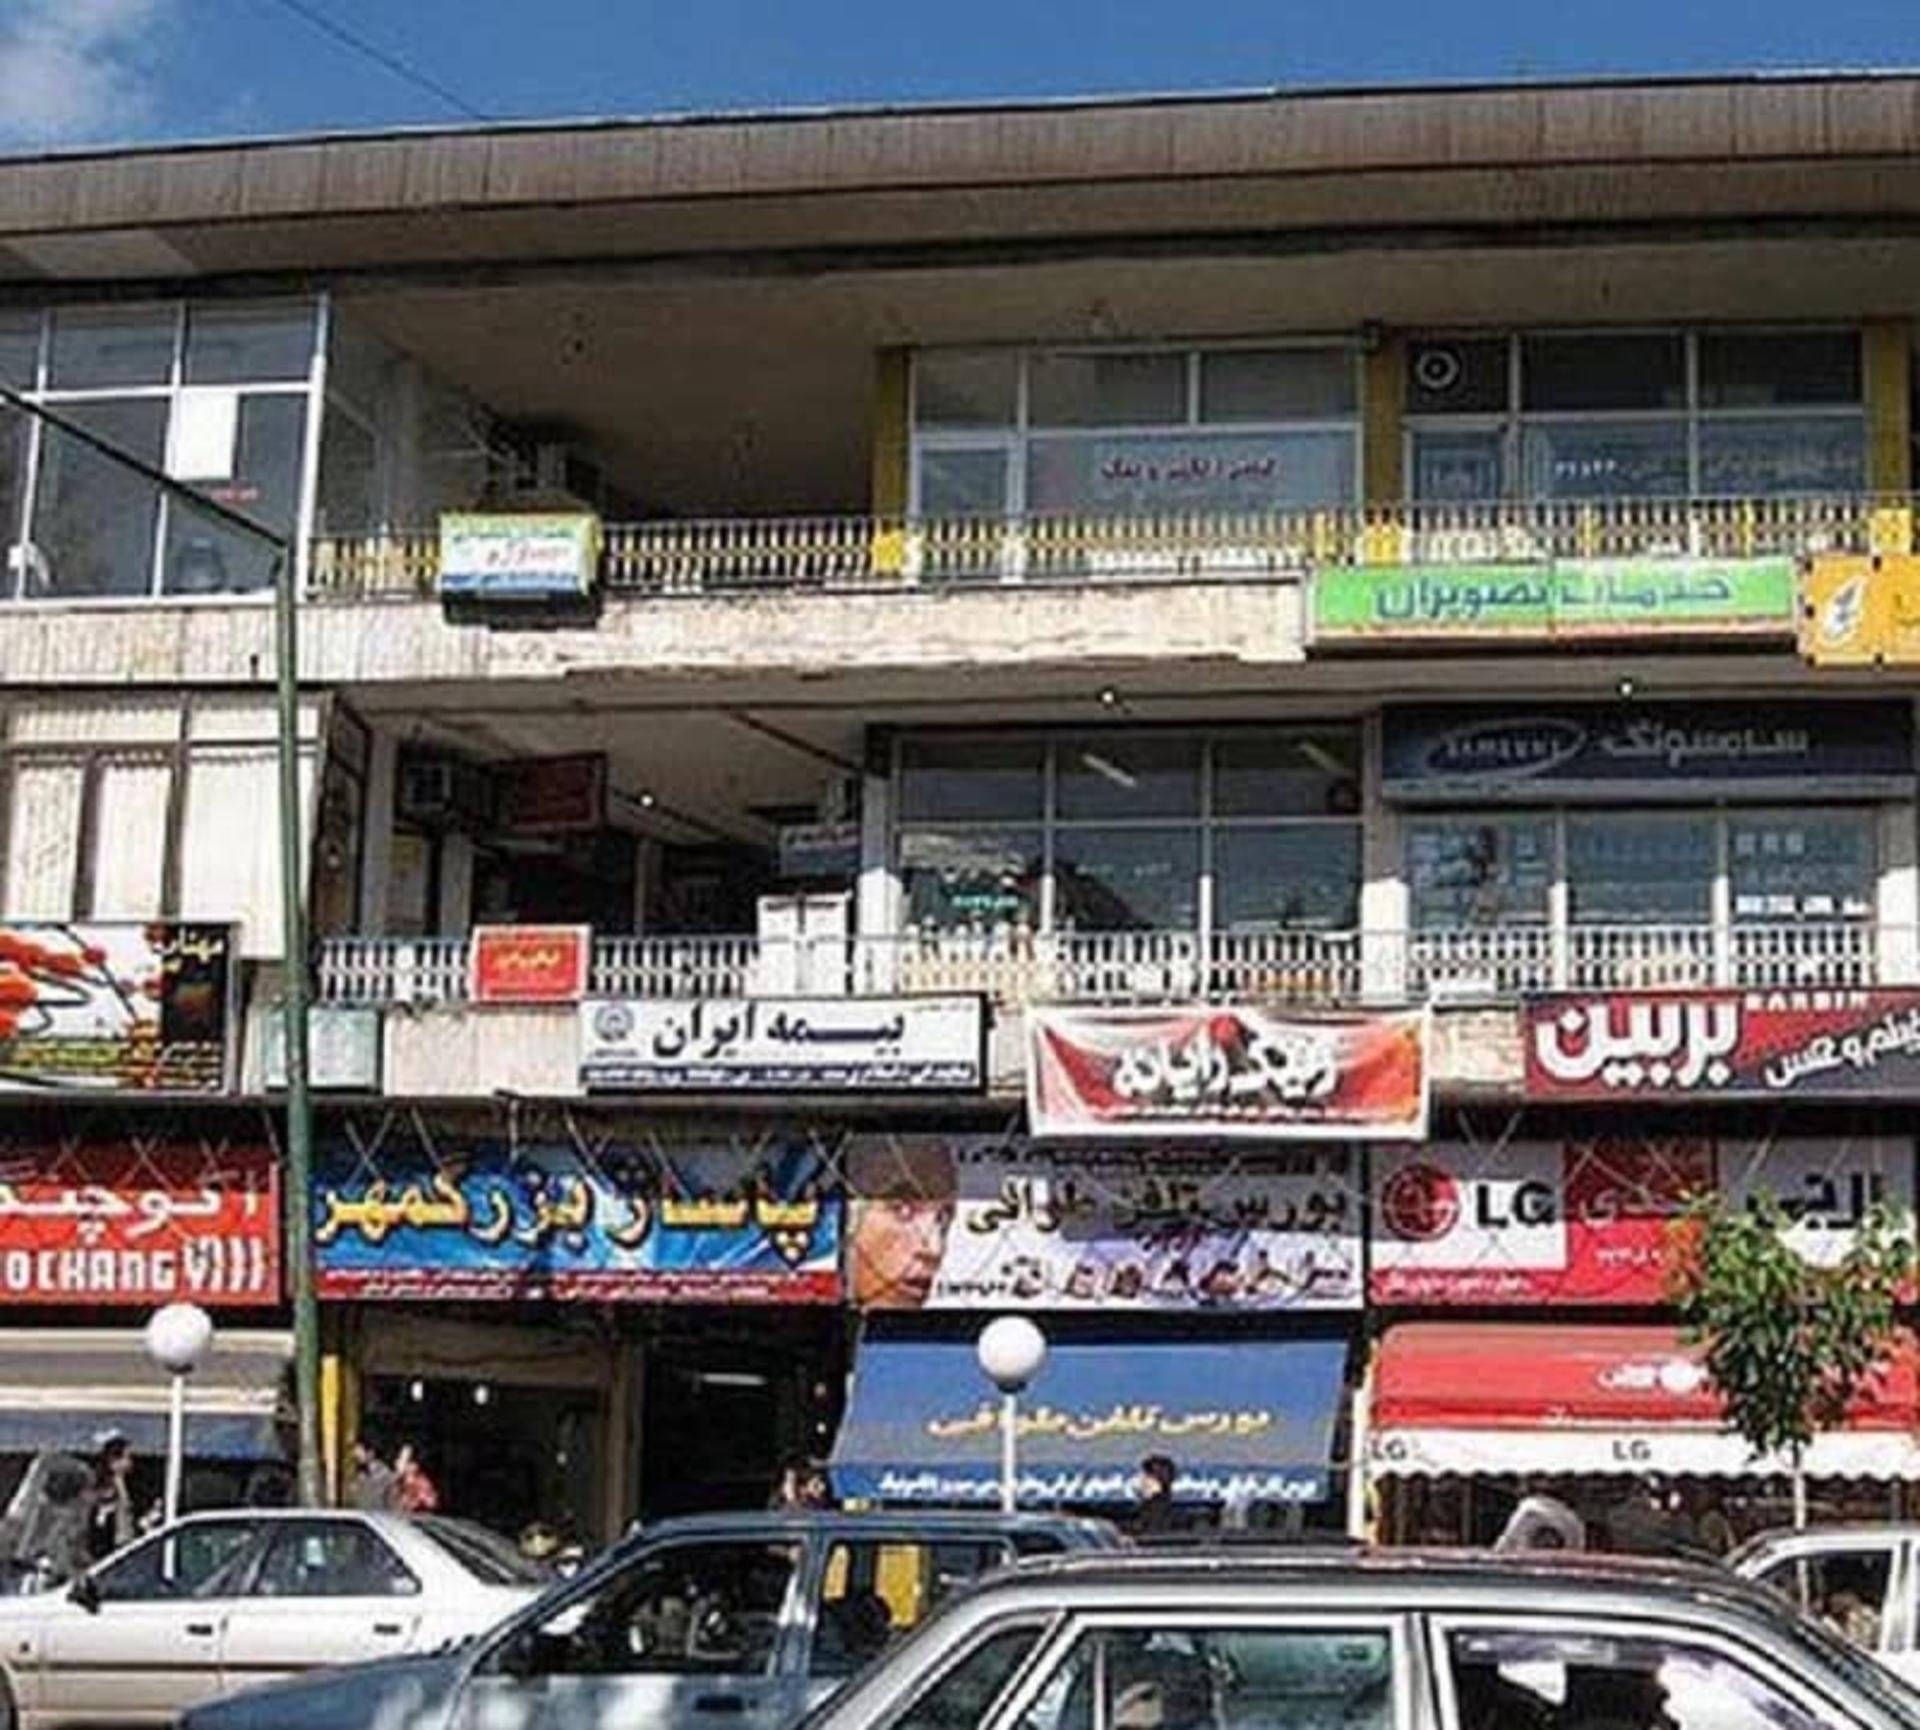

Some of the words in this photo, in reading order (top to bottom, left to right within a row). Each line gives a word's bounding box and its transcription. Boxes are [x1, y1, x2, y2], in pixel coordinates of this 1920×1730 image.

[652, 1003, 757, 1058] ایران
[767, 1010, 905, 1055] بیمه
[1535, 1001, 1740, 1087] بربین
[1475, 1184, 1557, 1228] LG
[1371, 1440, 1408, 1461] LG
[1612, 1440, 1653, 1461] LG
